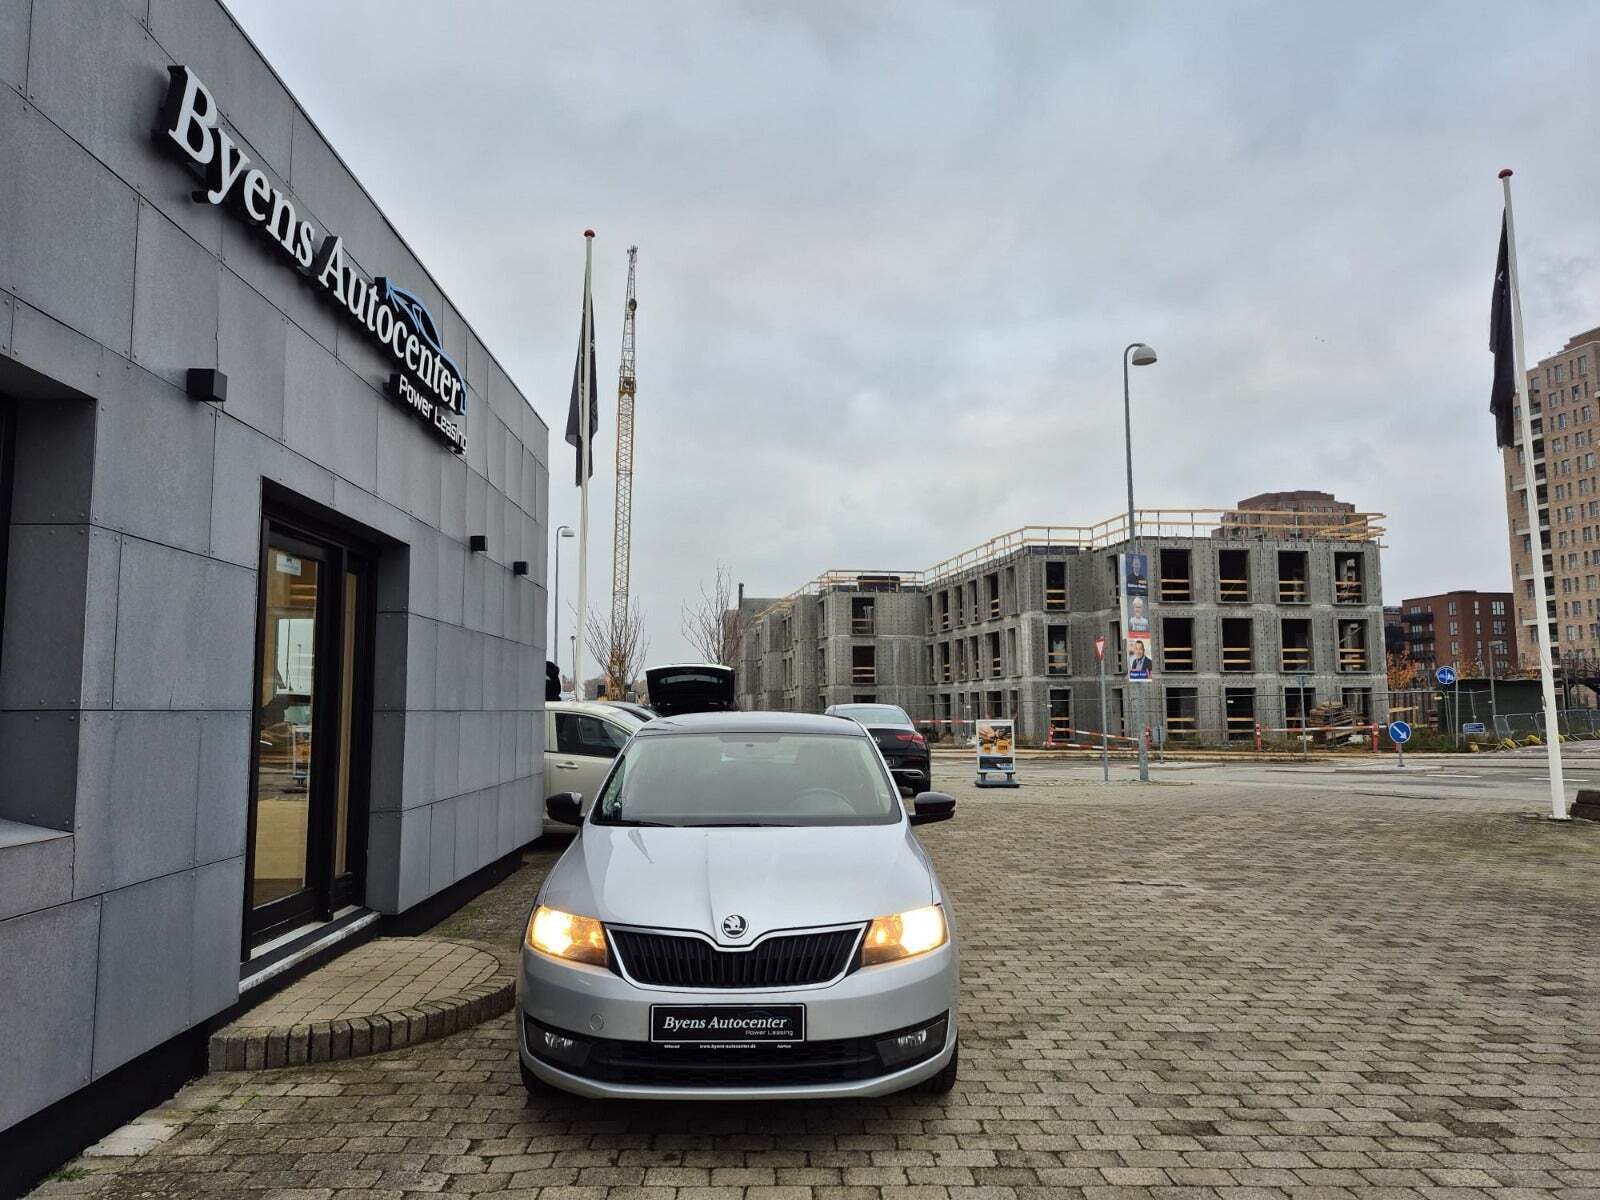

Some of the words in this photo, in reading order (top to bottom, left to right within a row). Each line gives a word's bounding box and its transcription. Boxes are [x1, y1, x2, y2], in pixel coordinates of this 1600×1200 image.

[167, 65, 316, 269] Byens
[318, 236, 462, 411] Autocenter
[399, 373, 433, 419] Power
[434, 405, 468, 455] Leasing
[664, 1016, 706, 1032] Byens
[708, 1016, 787, 1029] Autocenter
